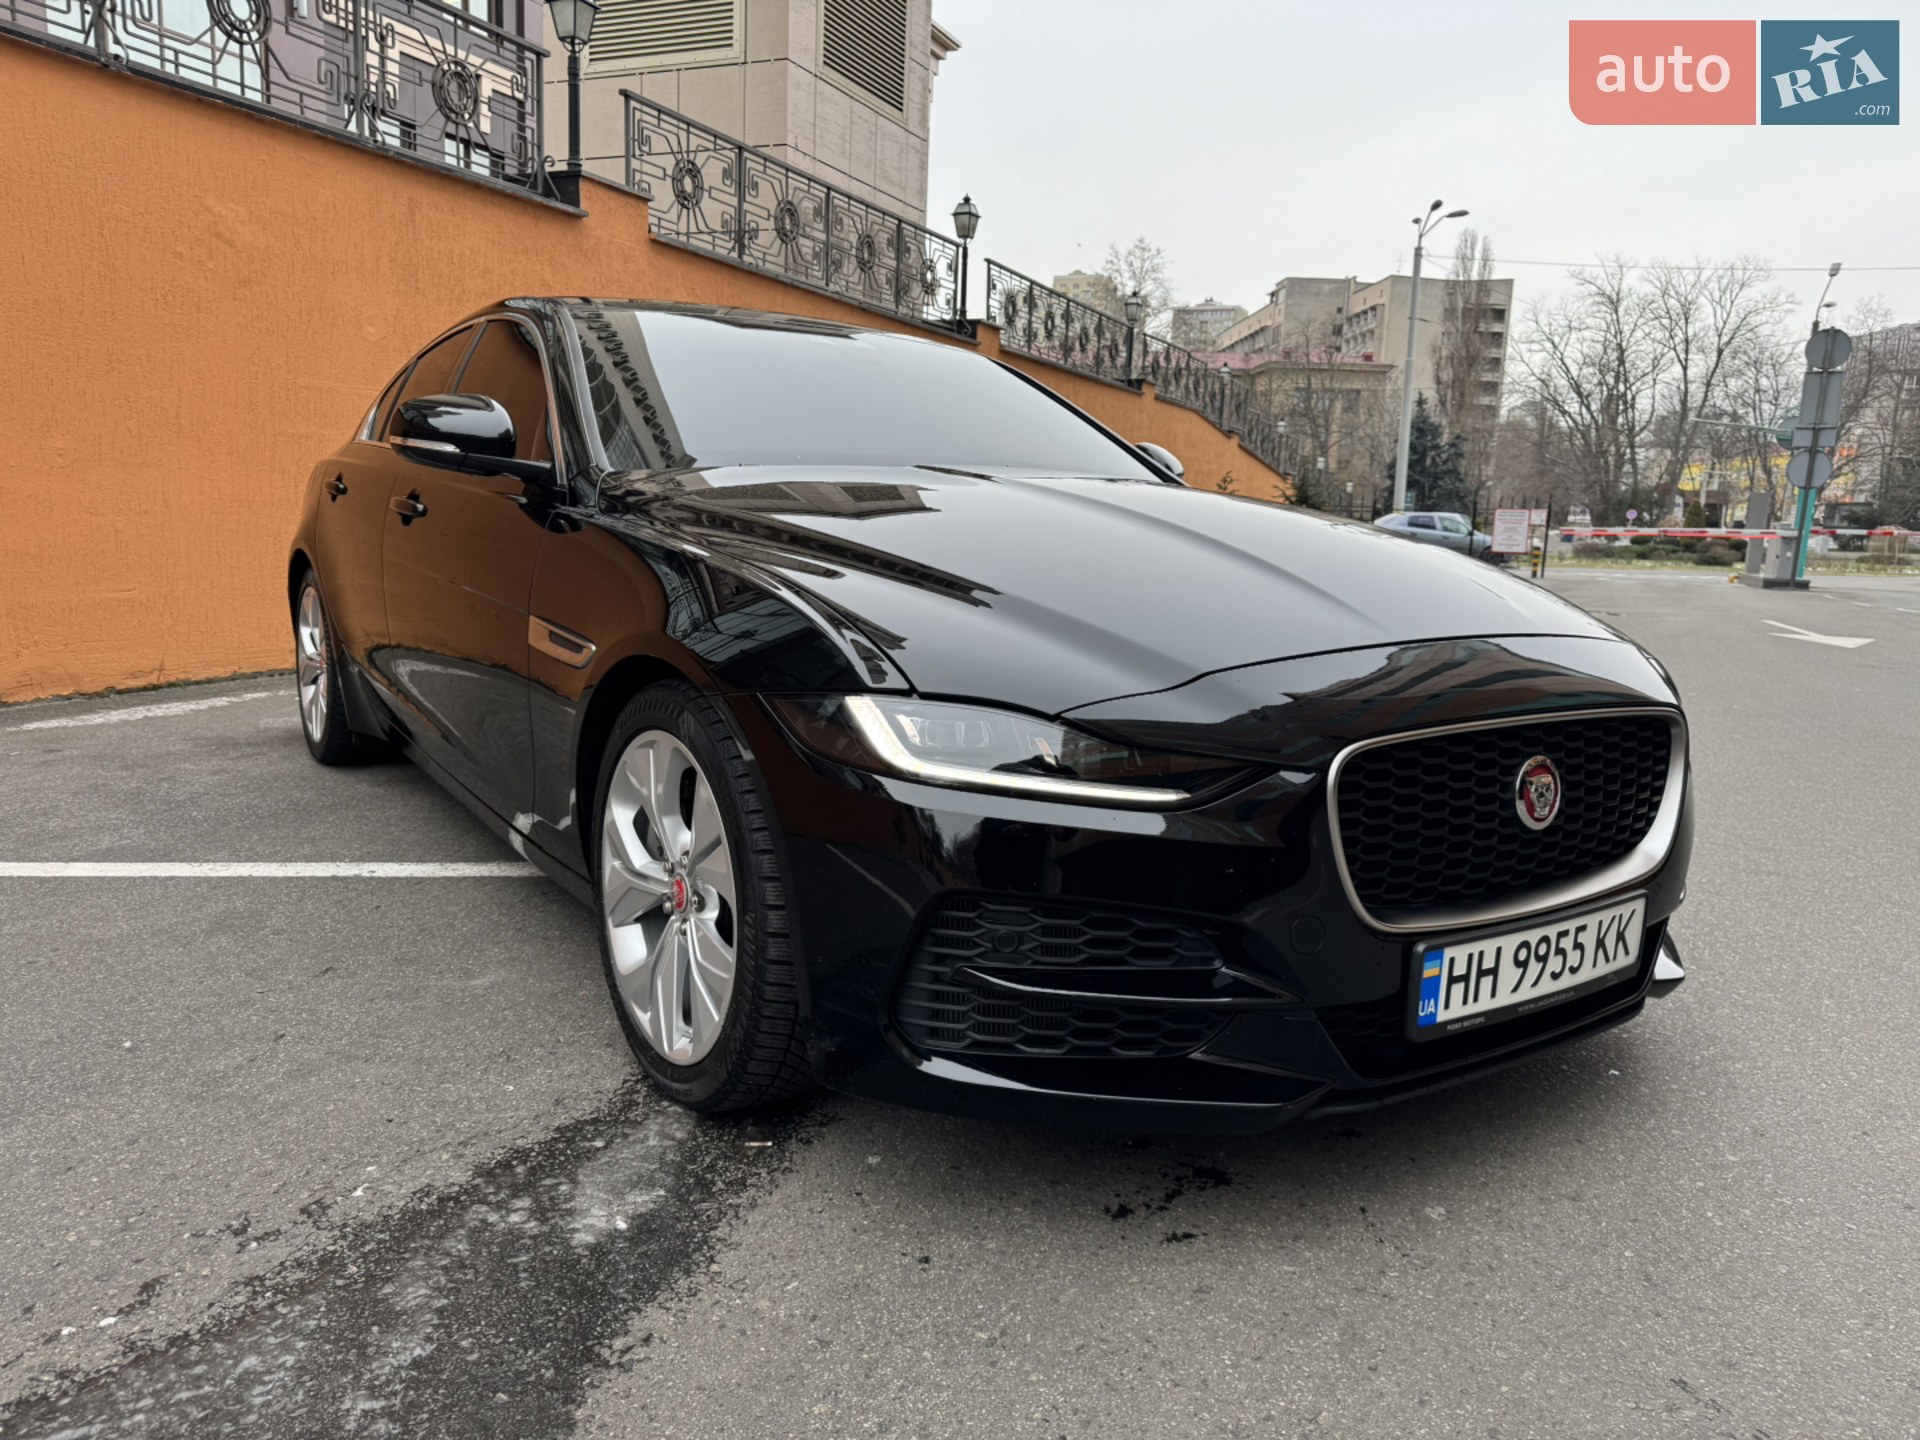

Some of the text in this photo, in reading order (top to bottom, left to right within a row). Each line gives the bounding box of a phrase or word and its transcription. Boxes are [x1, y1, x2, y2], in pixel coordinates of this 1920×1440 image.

[1443, 908, 1637, 1011] HH 9955 KK
[1418, 999, 1436, 1017] UA
